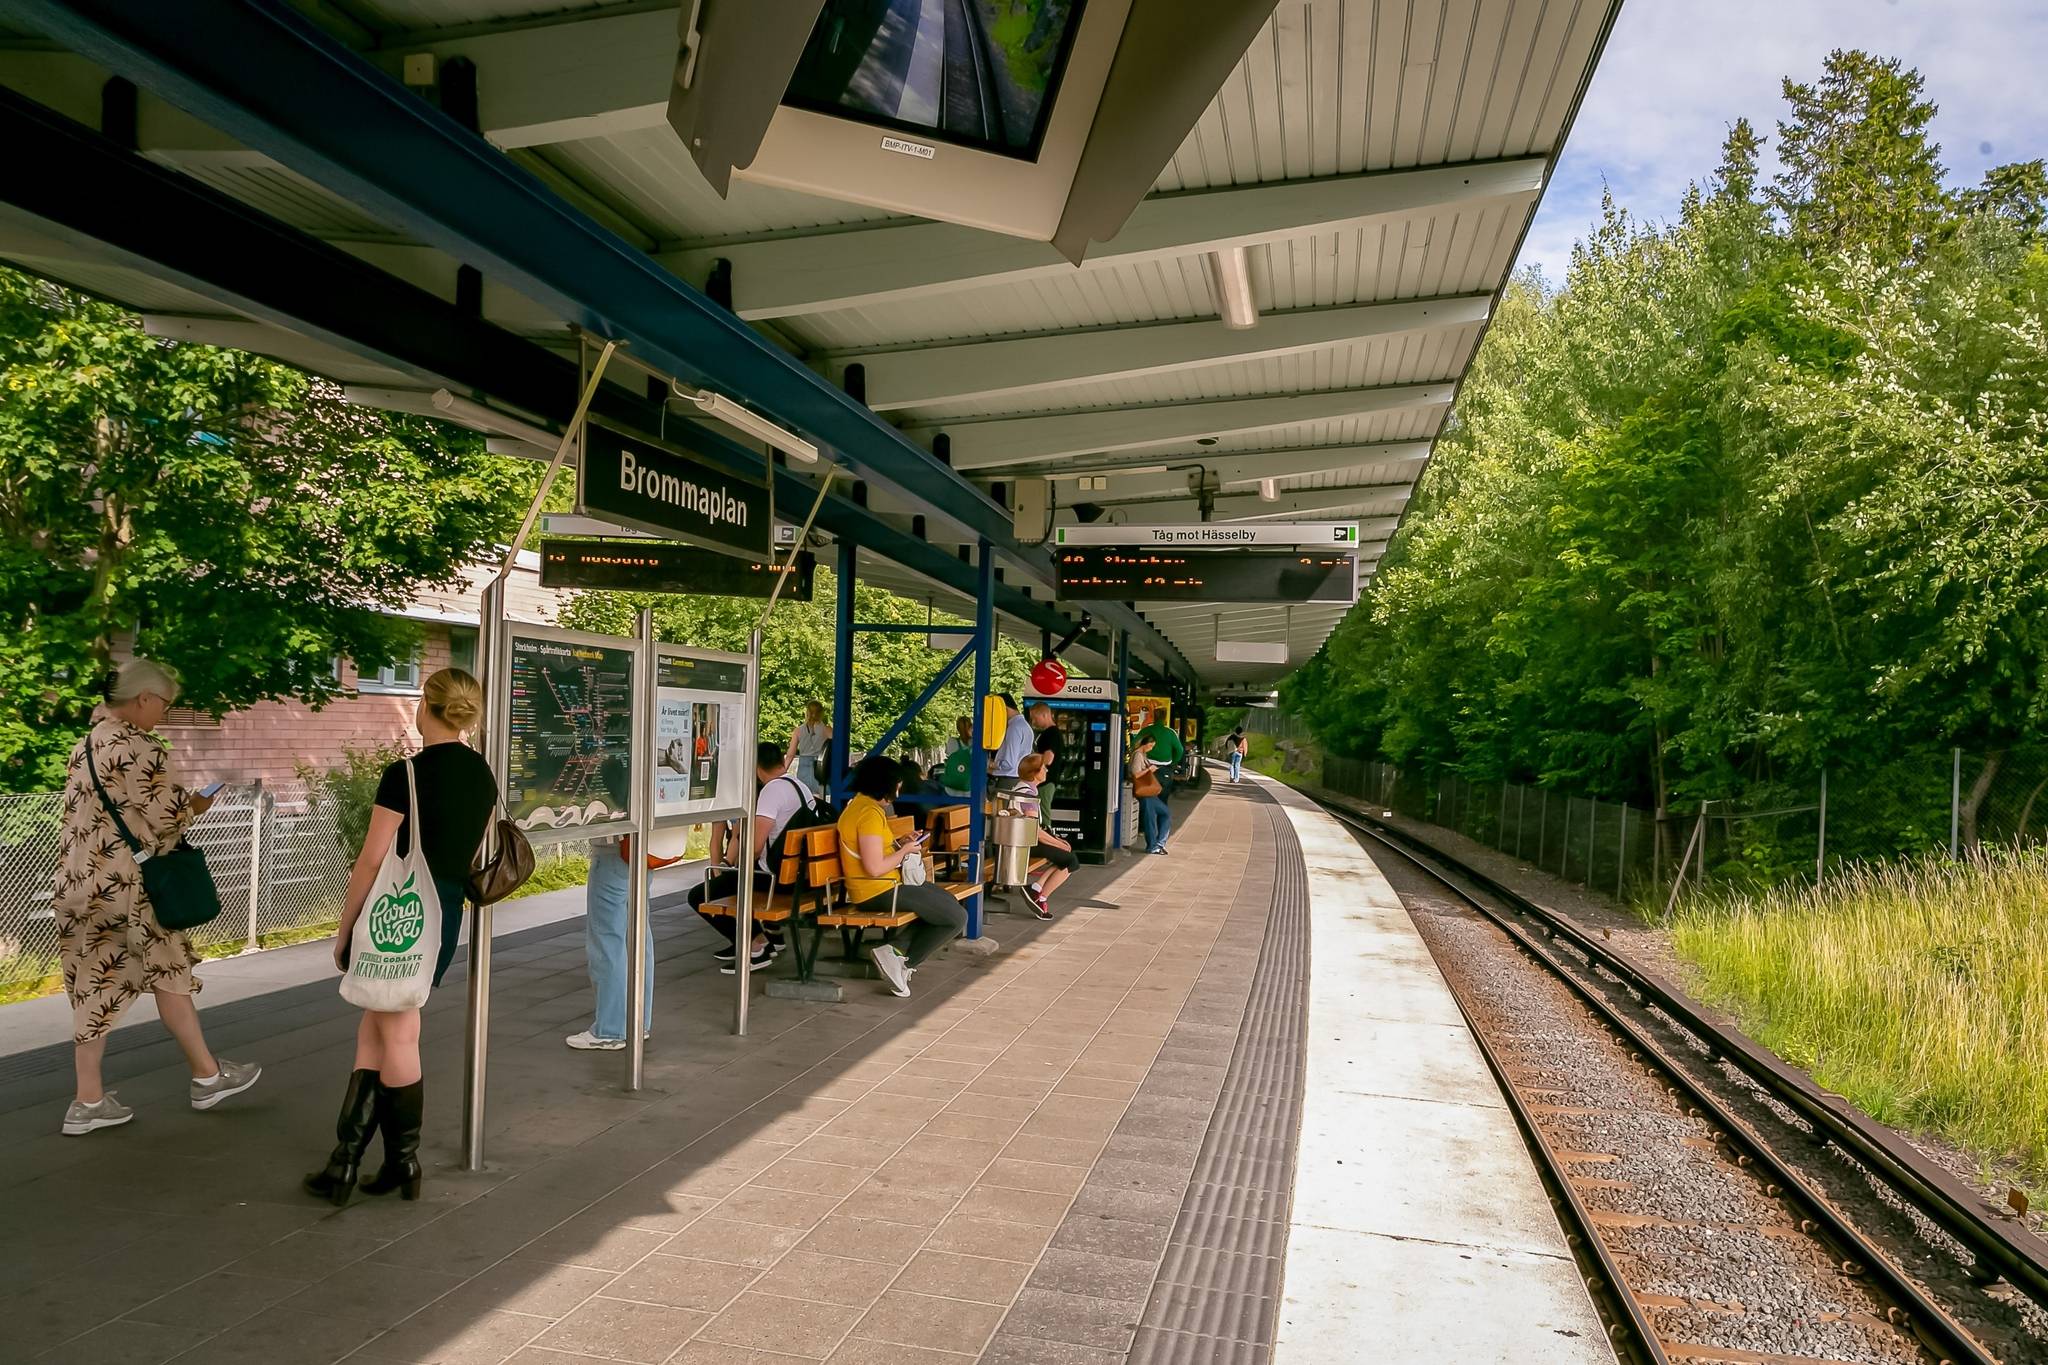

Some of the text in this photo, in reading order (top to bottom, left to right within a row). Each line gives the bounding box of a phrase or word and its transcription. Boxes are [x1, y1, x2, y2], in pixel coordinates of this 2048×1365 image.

[620, 449, 748, 528] Brommaplan
[1152, 528, 1257, 543] Tåg mot Hässelby
[1066, 684, 1103, 695] selecta
[383, 953, 424, 963] GODASTE
[354, 961, 420, 980] MATMARKNAD
